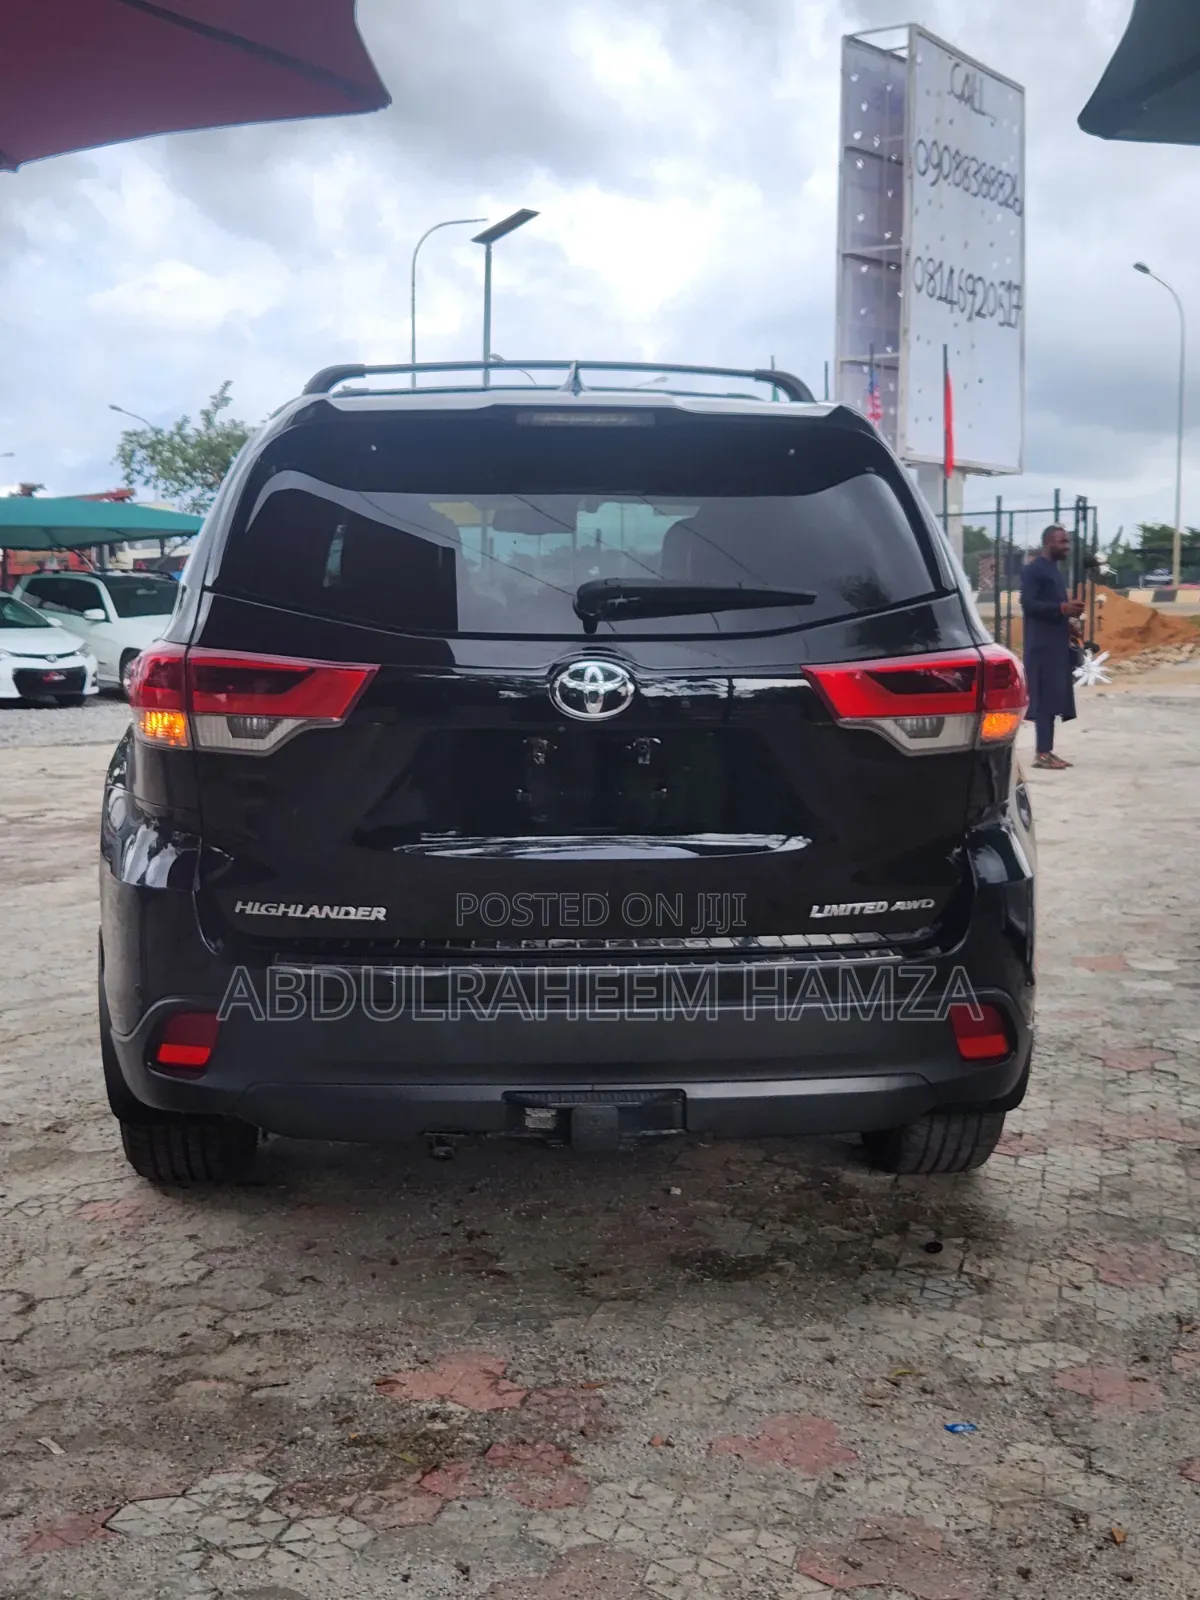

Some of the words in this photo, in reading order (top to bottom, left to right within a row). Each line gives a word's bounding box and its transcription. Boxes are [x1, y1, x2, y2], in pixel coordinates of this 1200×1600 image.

[234, 900, 388, 922] HIGHLANDER
[809, 901, 888, 919] LIMITED
[890, 898, 935, 912] AWD
